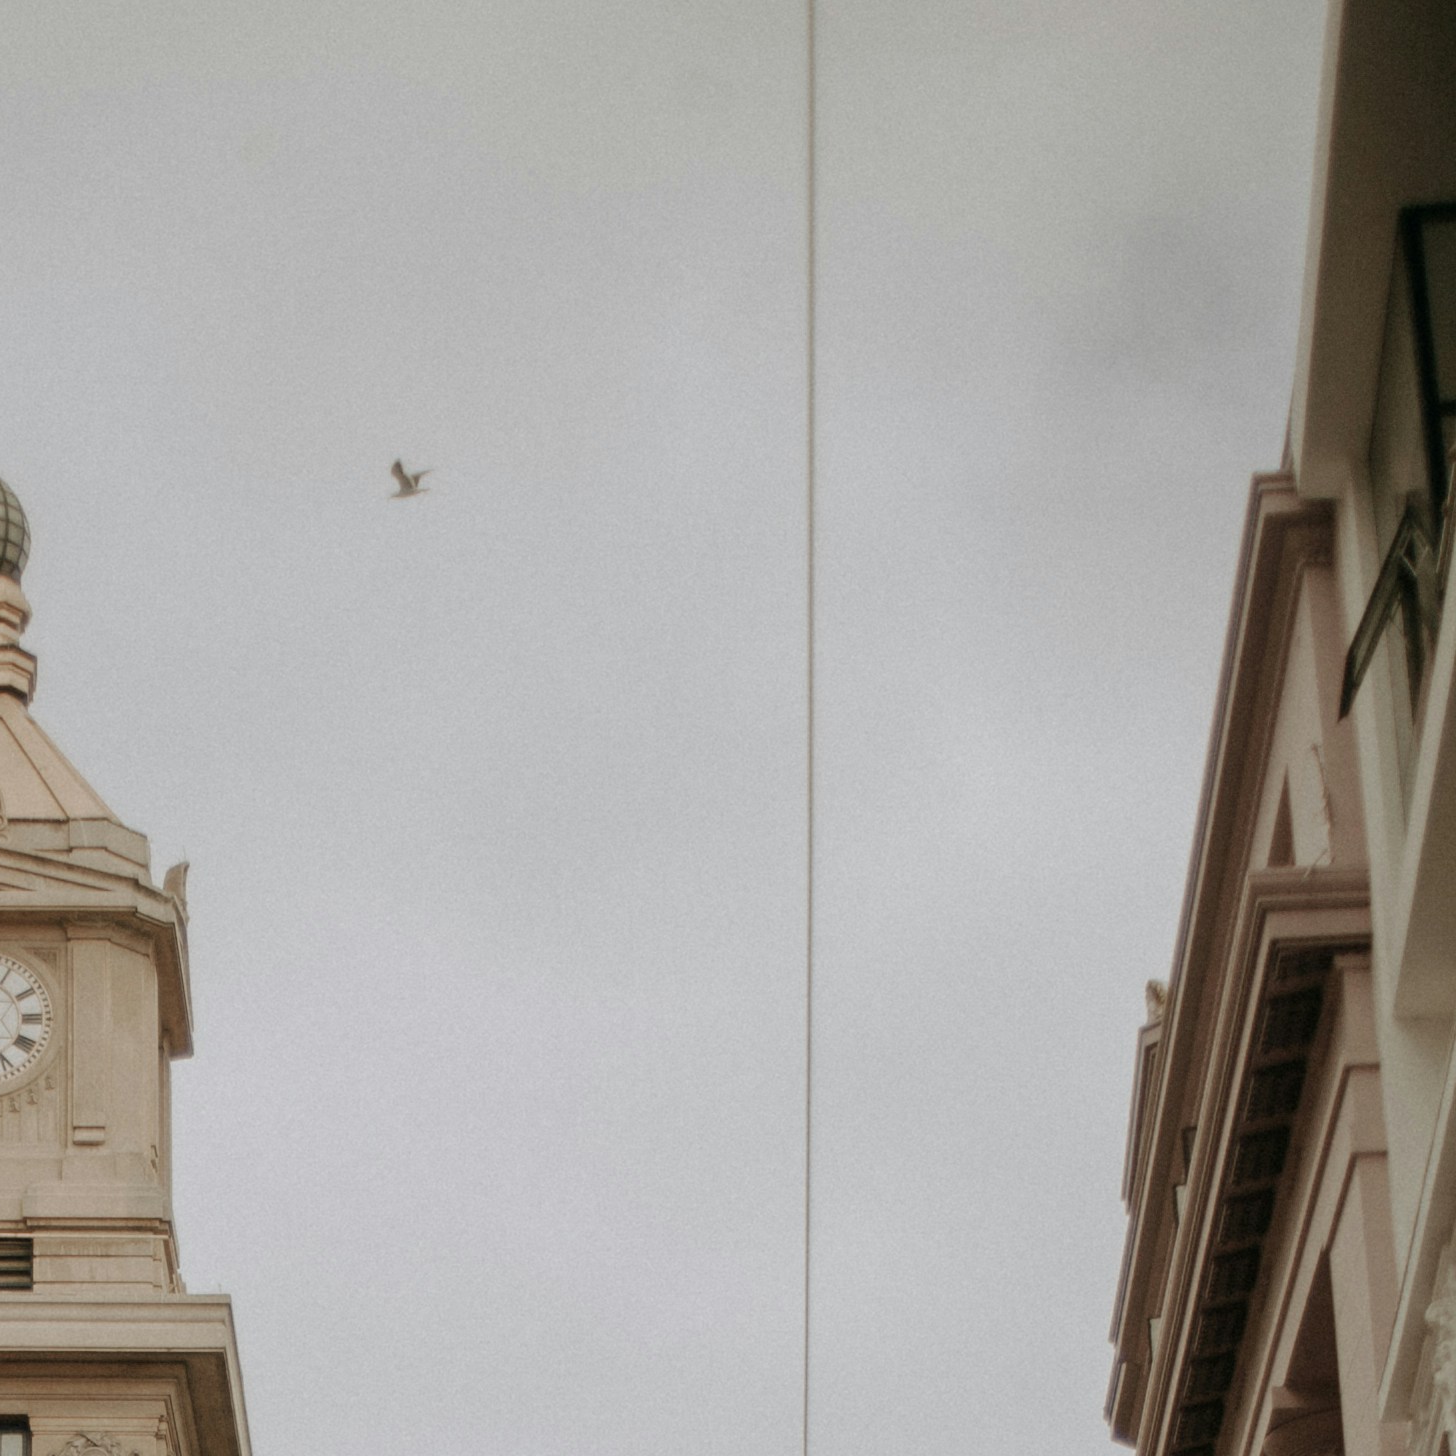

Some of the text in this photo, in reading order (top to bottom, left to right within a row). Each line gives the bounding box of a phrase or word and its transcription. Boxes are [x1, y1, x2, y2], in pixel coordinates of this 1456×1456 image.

[0, 969, 11, 984] I
[16, 988, 35, 1001] II
[22, 1013, 43, 1025] III
